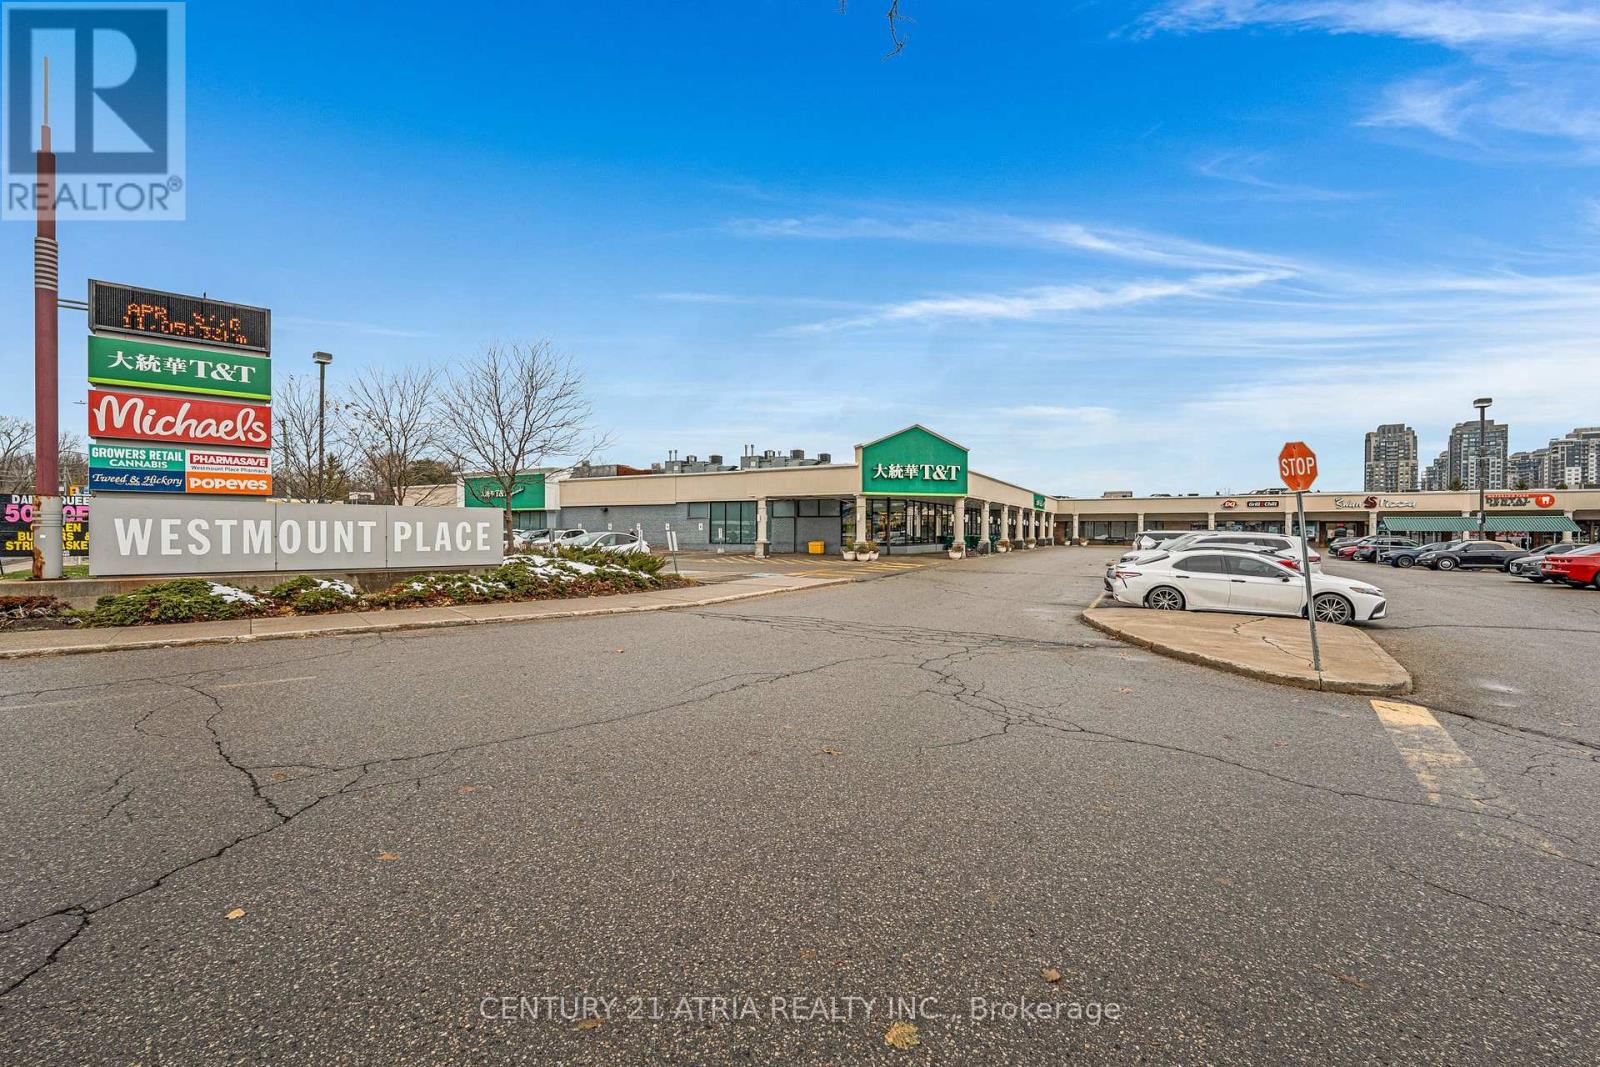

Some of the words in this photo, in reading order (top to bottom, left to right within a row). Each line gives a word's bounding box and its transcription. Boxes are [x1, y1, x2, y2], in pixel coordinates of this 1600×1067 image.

[189, 359, 256, 384] T&T
[93, 395, 267, 443] Michaels
[91, 447, 146, 460] GROWERS
[149, 450, 183, 461] RETAIL
[192, 454, 266, 466] PHARMASAVE
[109, 458, 168, 469] CANNABIS
[1281, 457, 1315, 477] STOP
[919, 464, 960, 480] T&T
[92, 473, 129, 484] Tweed
[129, 475, 140, 484] &
[143, 475, 183, 488] Hickory
[114, 518, 376, 555] WESTMOUNT
[393, 521, 491, 552] PLACE
